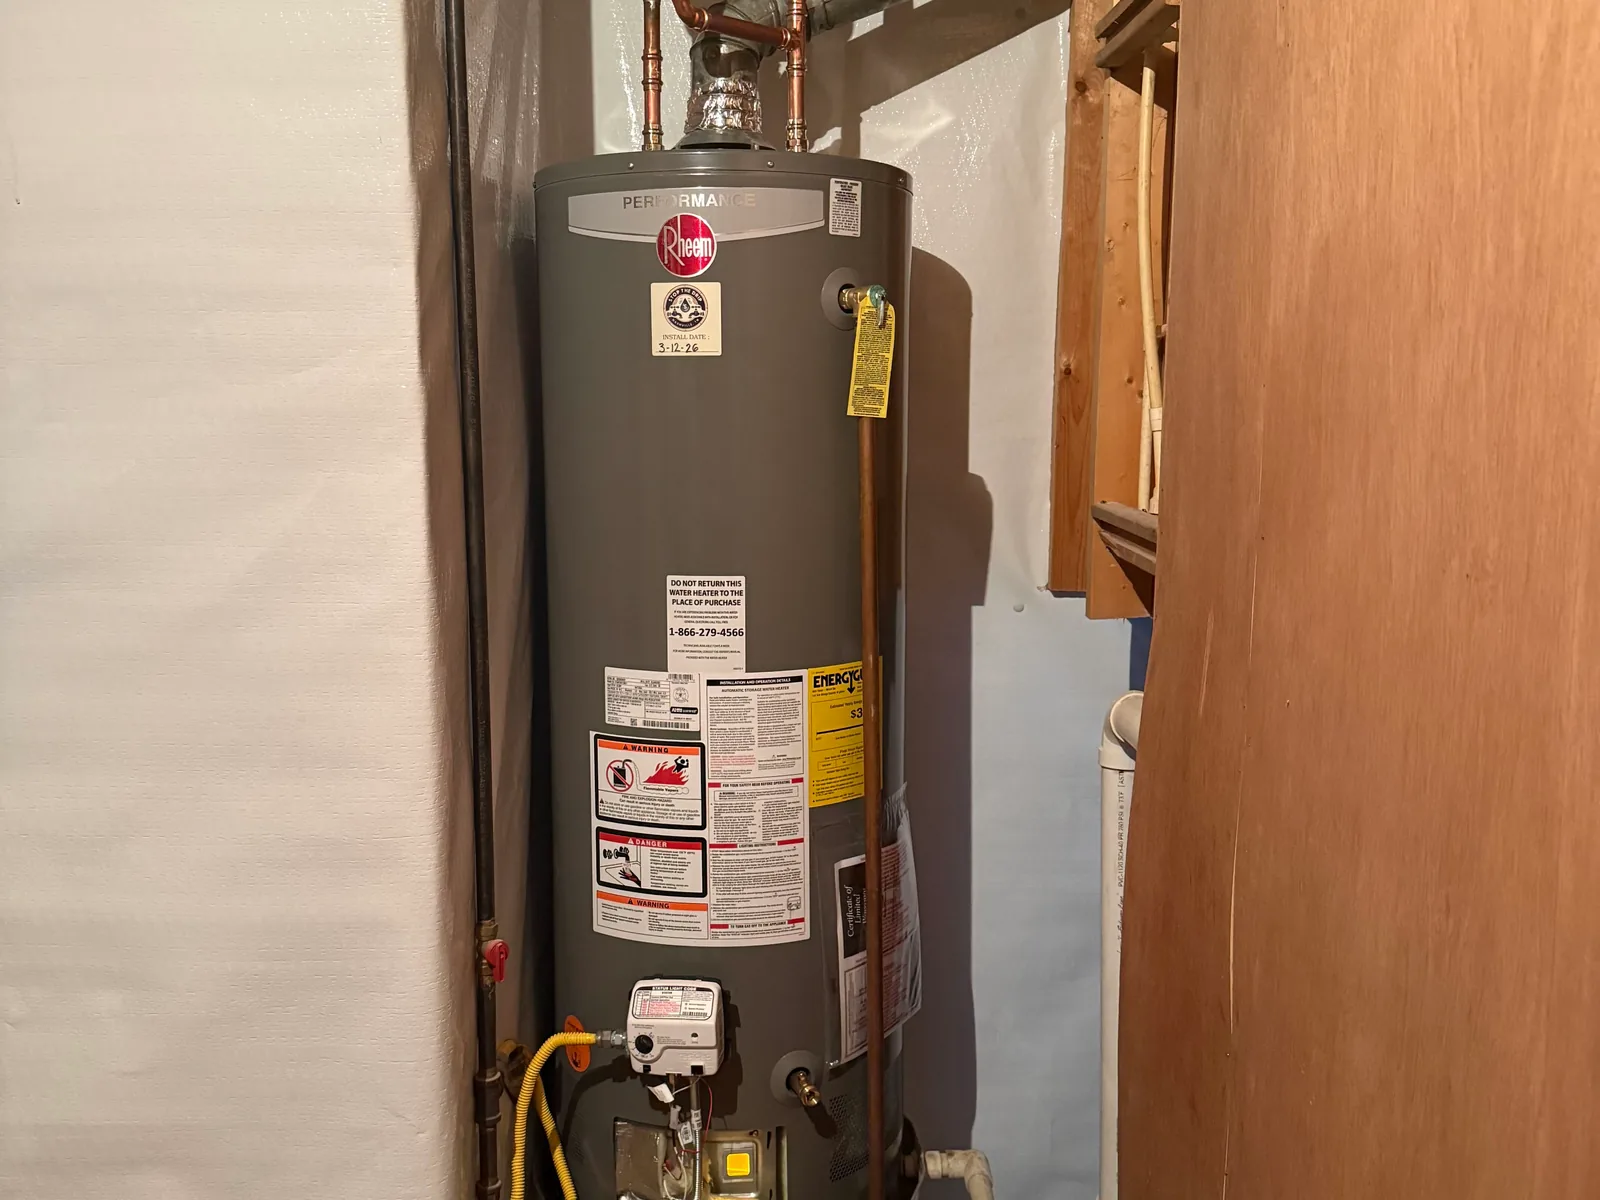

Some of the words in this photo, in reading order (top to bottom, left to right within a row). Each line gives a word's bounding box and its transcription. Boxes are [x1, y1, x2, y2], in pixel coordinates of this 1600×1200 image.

[623, 193, 756, 209] PERFORMANCE
[664, 214, 712, 266] Rheem
[668, 290, 680, 302] STOP
[691, 290, 702, 301] DRIP
[658, 342, 699, 353] 3-12-26
[669, 627, 744, 637] 1-866-279-4566
[631, 744, 668, 753] WARNING
[636, 839, 668, 848] DANGER
[844, 884, 853, 894] of
[636, 900, 670, 909] WARNING
[853, 894, 861, 924] Limited
[846, 896, 855, 937] Certificate
